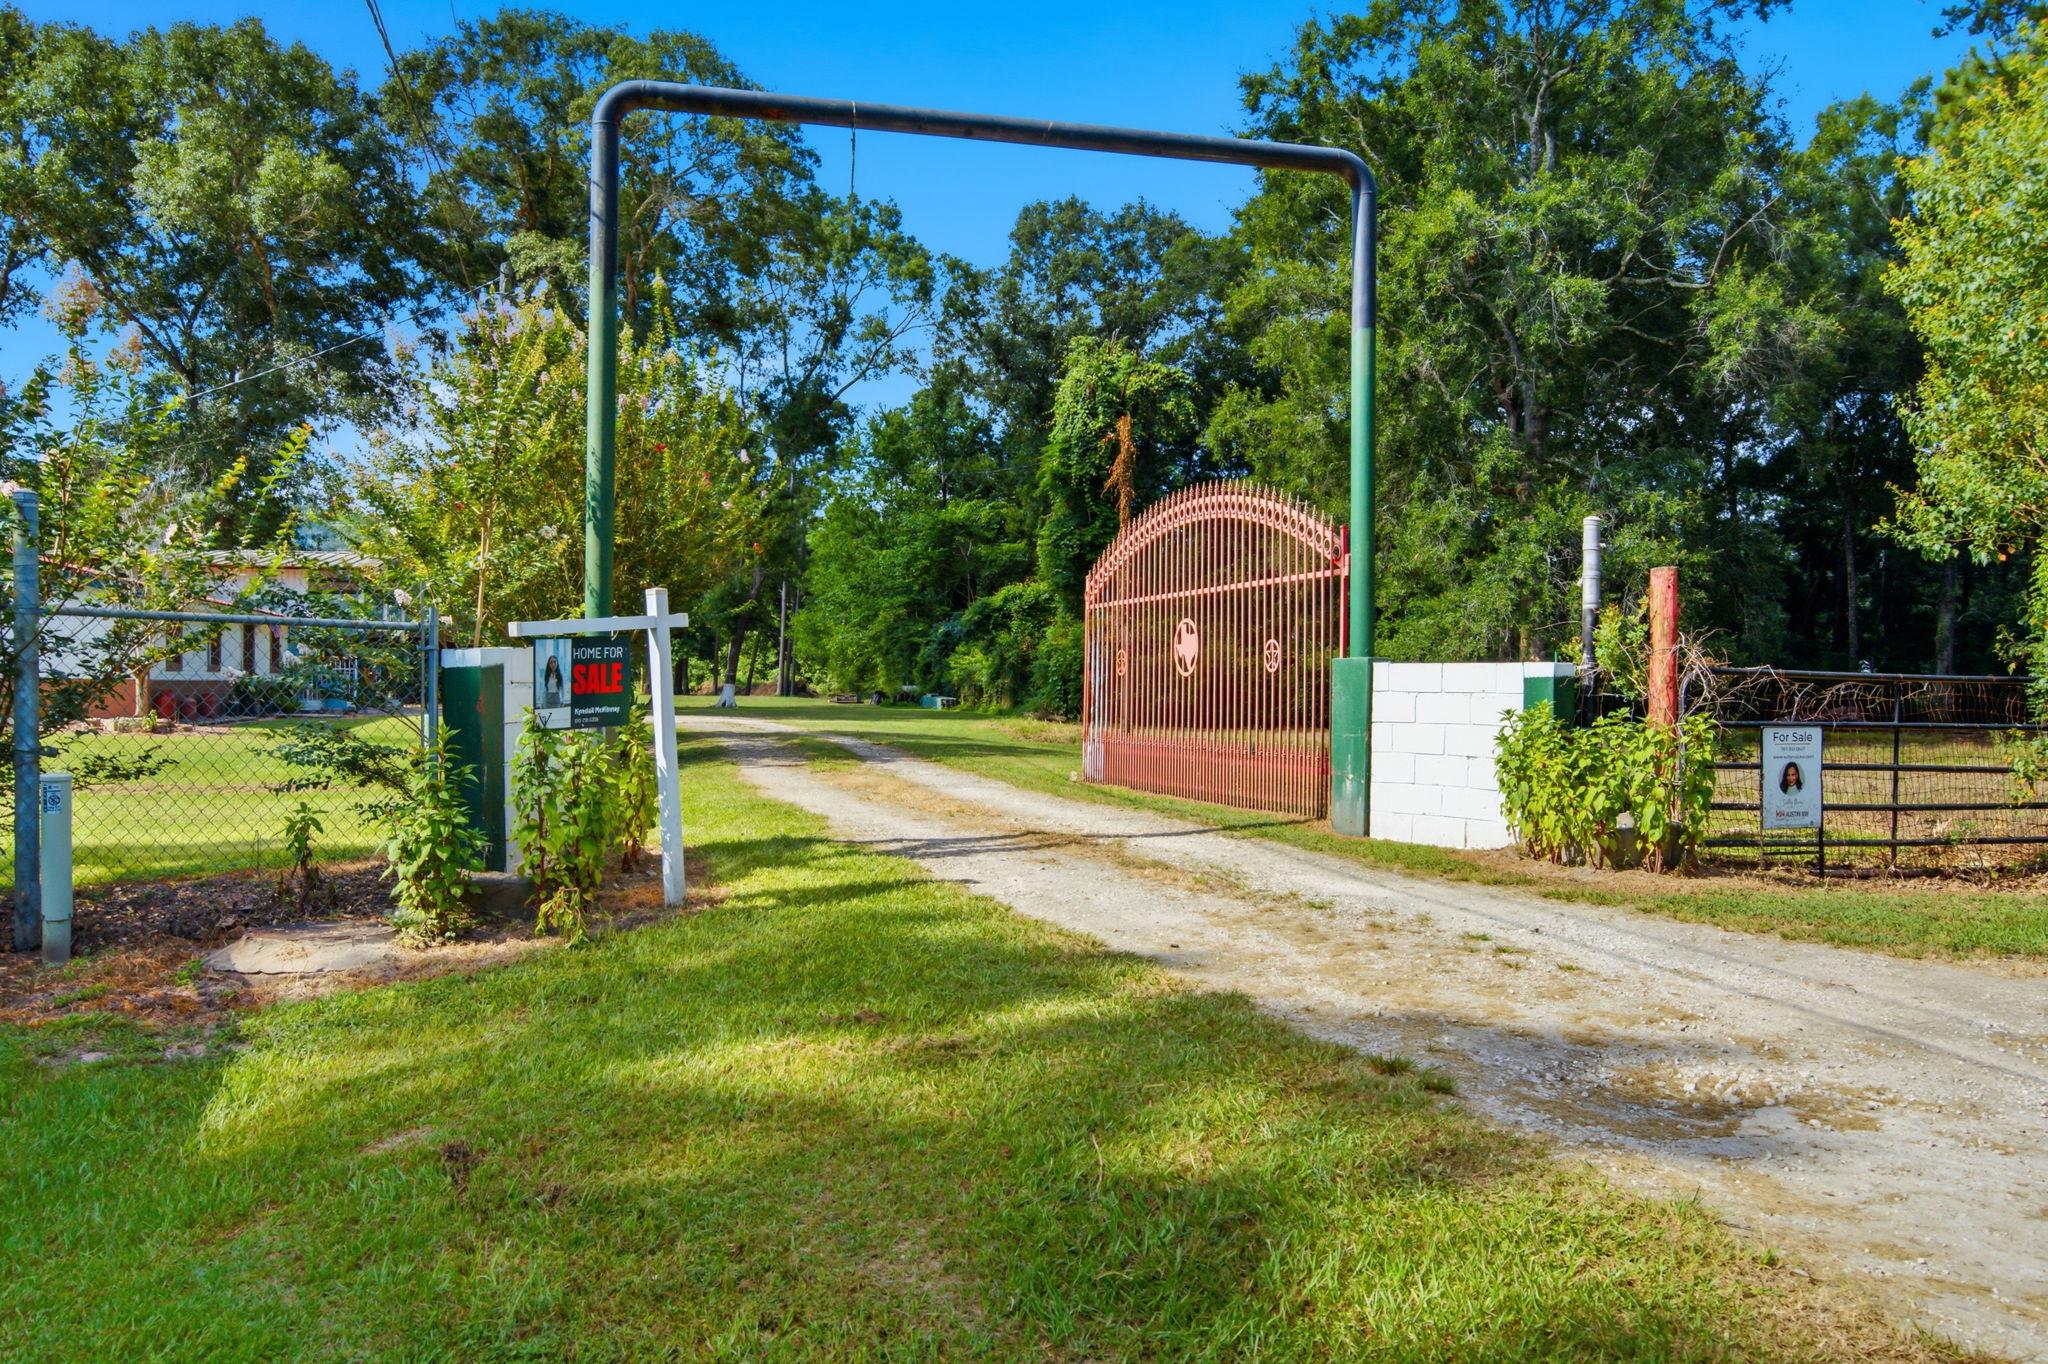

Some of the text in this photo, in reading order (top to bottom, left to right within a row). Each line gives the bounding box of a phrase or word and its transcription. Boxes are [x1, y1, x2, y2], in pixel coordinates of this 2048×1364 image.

[573, 647, 623, 660] HOME FOR
[573, 662, 624, 695] SALE
[1773, 732, 1812, 742] For Sale
